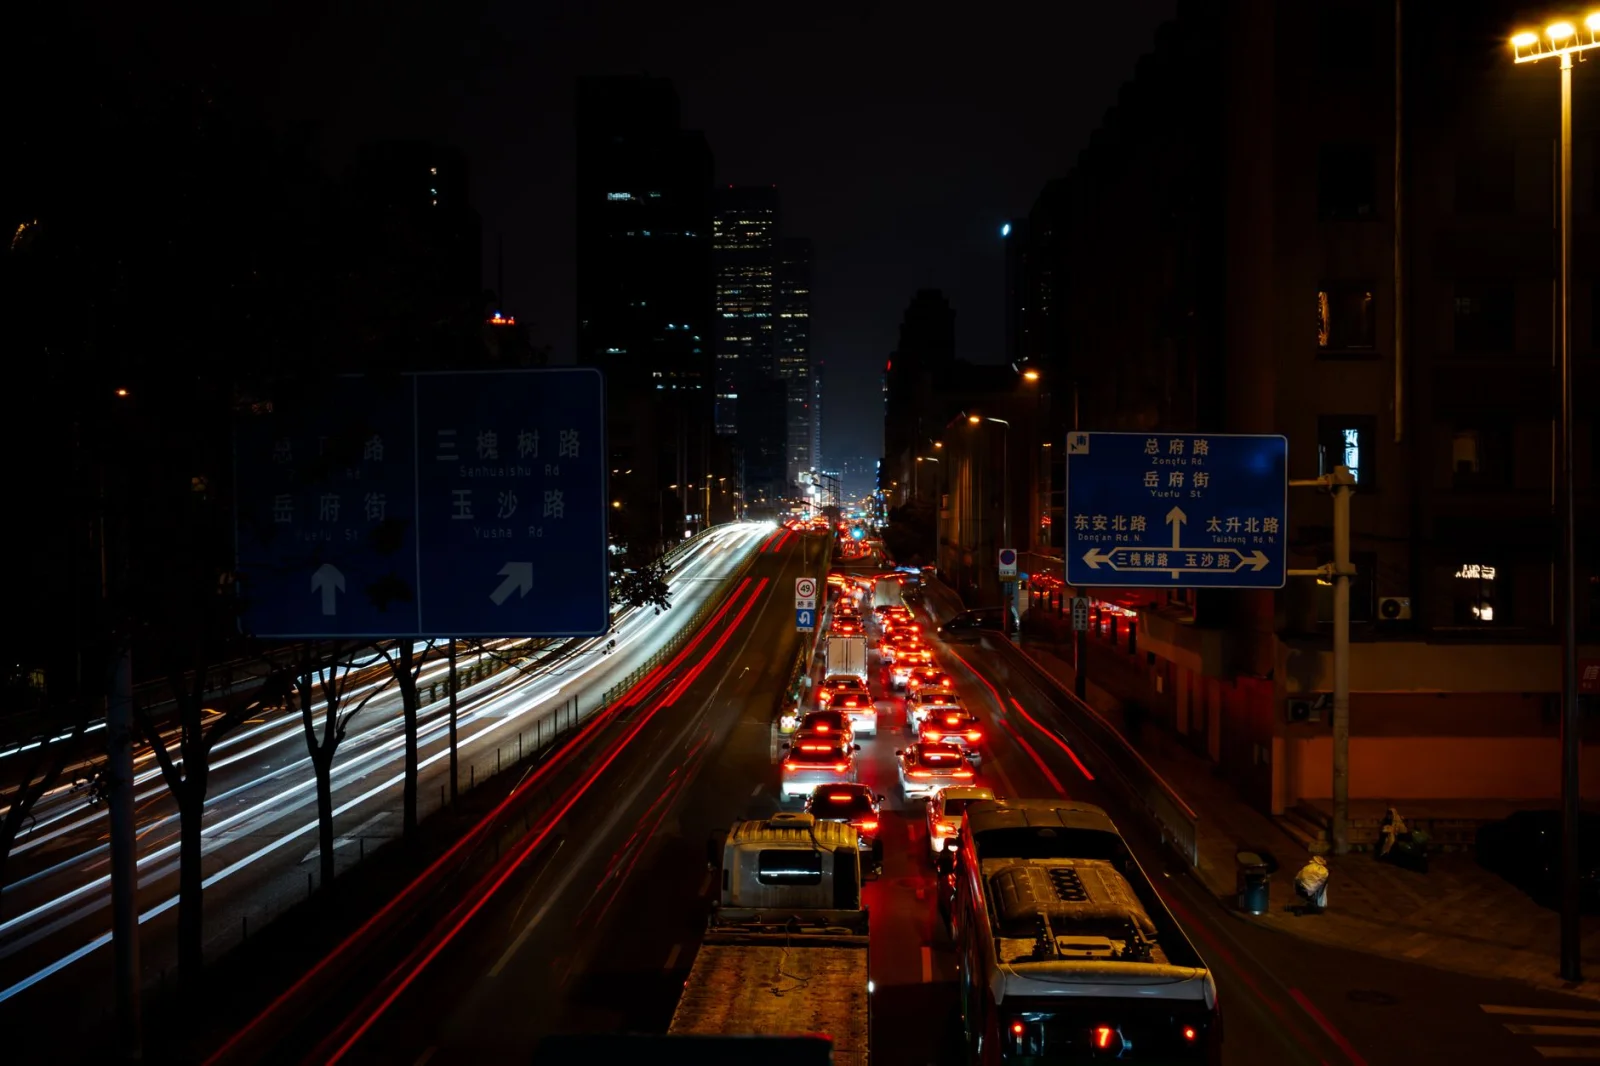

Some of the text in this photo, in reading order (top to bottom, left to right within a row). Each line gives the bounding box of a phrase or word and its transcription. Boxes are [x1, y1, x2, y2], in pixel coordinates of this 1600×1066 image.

[435, 428, 582, 462] 三槐树路
[1143, 437, 1210, 456] 总府路
[458, 464, 532, 478] Sanhuaishu
[1152, 456, 1187, 467] Zongfu
[1143, 469, 1211, 489] 岳府街
[1150, 489, 1181, 498] Yuefu
[271, 491, 388, 524] 岳府街
[450, 488, 566, 521] 玉沙路
[1073, 513, 1148, 533] 东安北路
[1206, 515, 1280, 535] 太升北路
[473, 526, 513, 540] Yusha
[1212, 535, 1247, 546] Taisheng
[1115, 552, 1231, 568] 三槐树路 玉沙路
